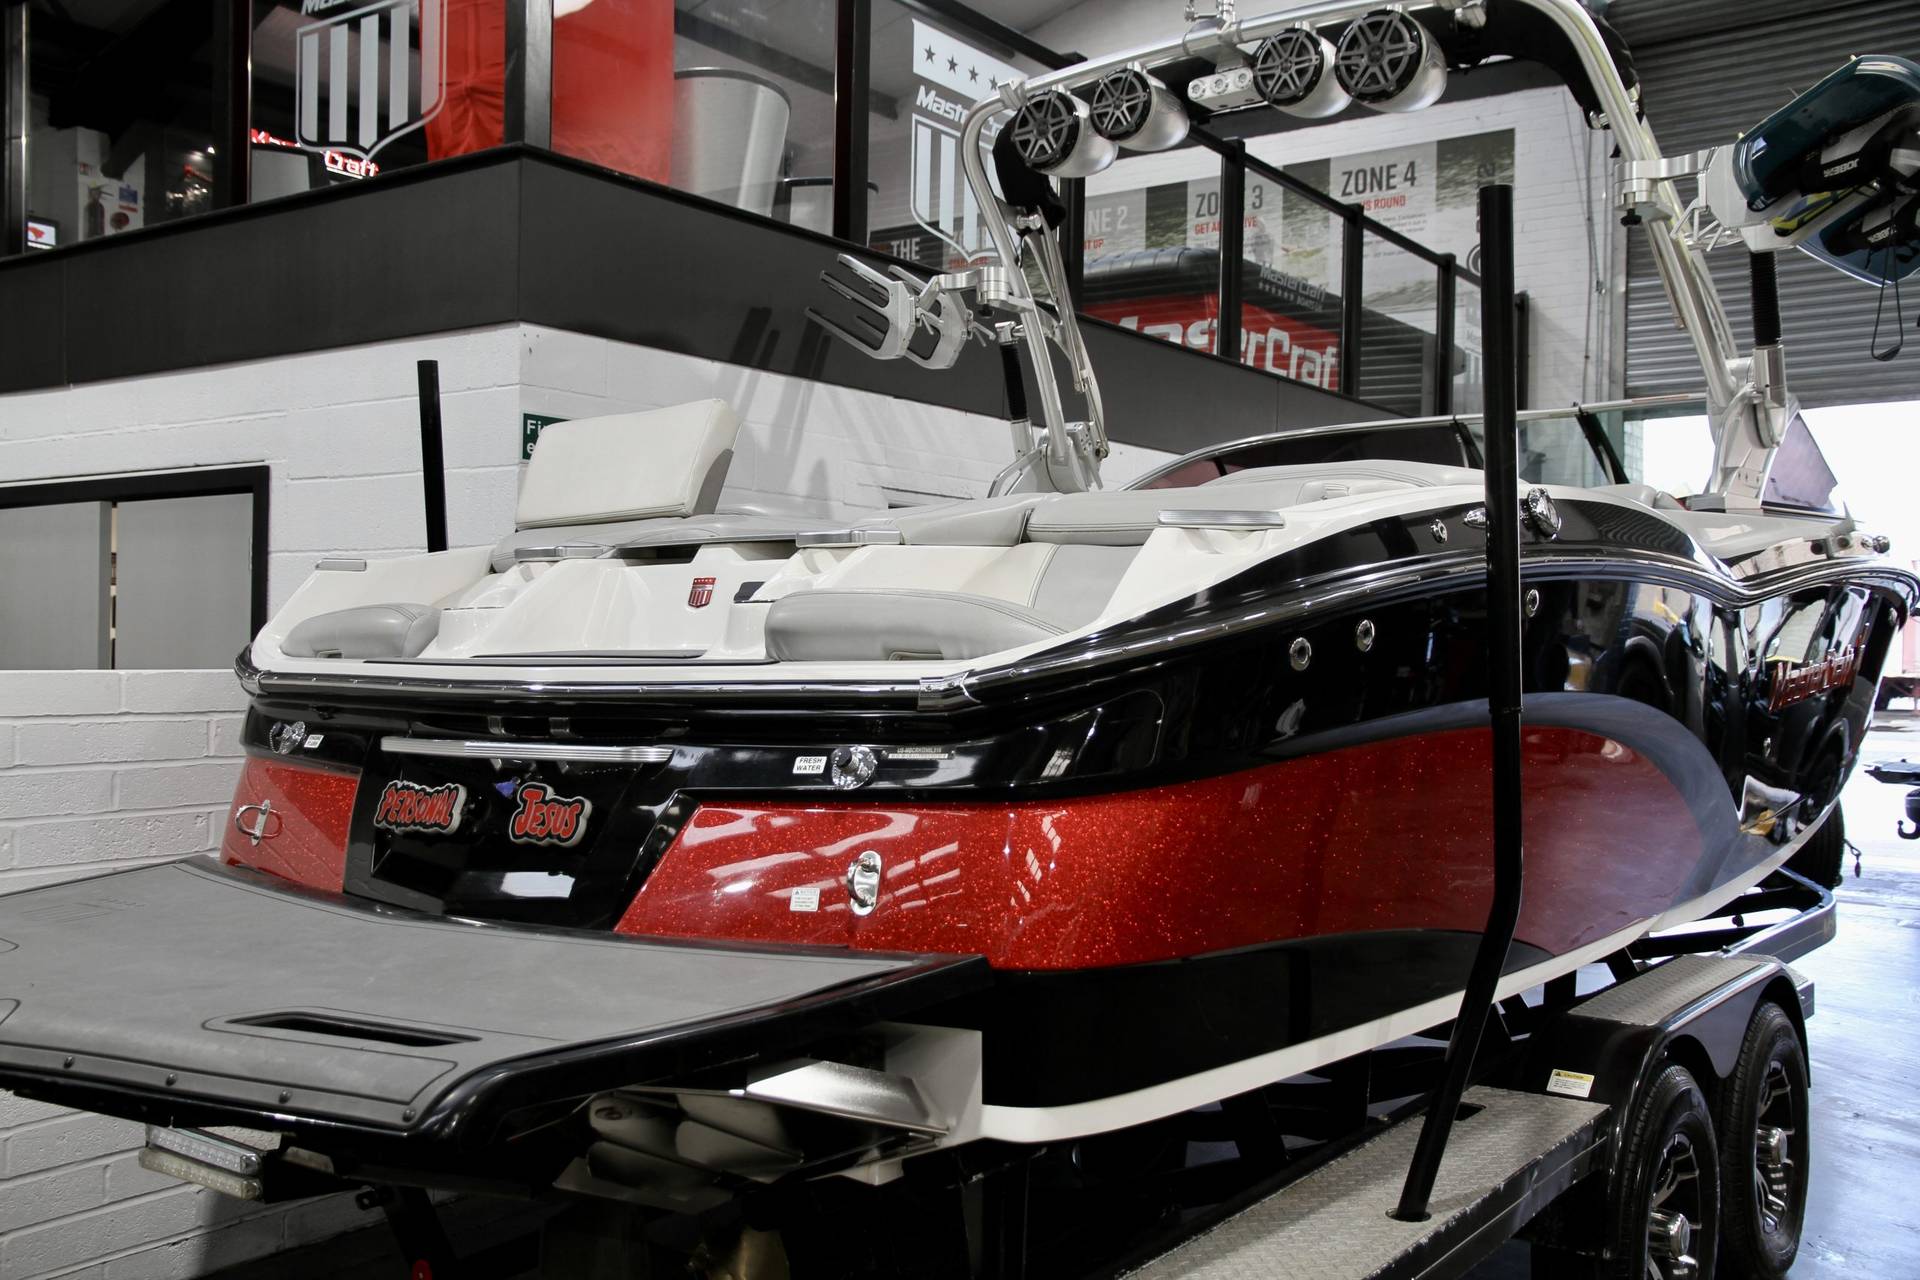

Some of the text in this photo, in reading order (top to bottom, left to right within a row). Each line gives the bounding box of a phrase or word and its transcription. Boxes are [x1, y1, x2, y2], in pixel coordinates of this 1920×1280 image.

[1341, 160, 1417, 197] ZONE 4
[1252, 184, 1264, 209] 3
[1374, 195, 1406, 210] ROUND
[1117, 205, 1128, 229] 2
[890, 238, 921, 260] THE
[378, 786, 457, 826] PERSONAL
